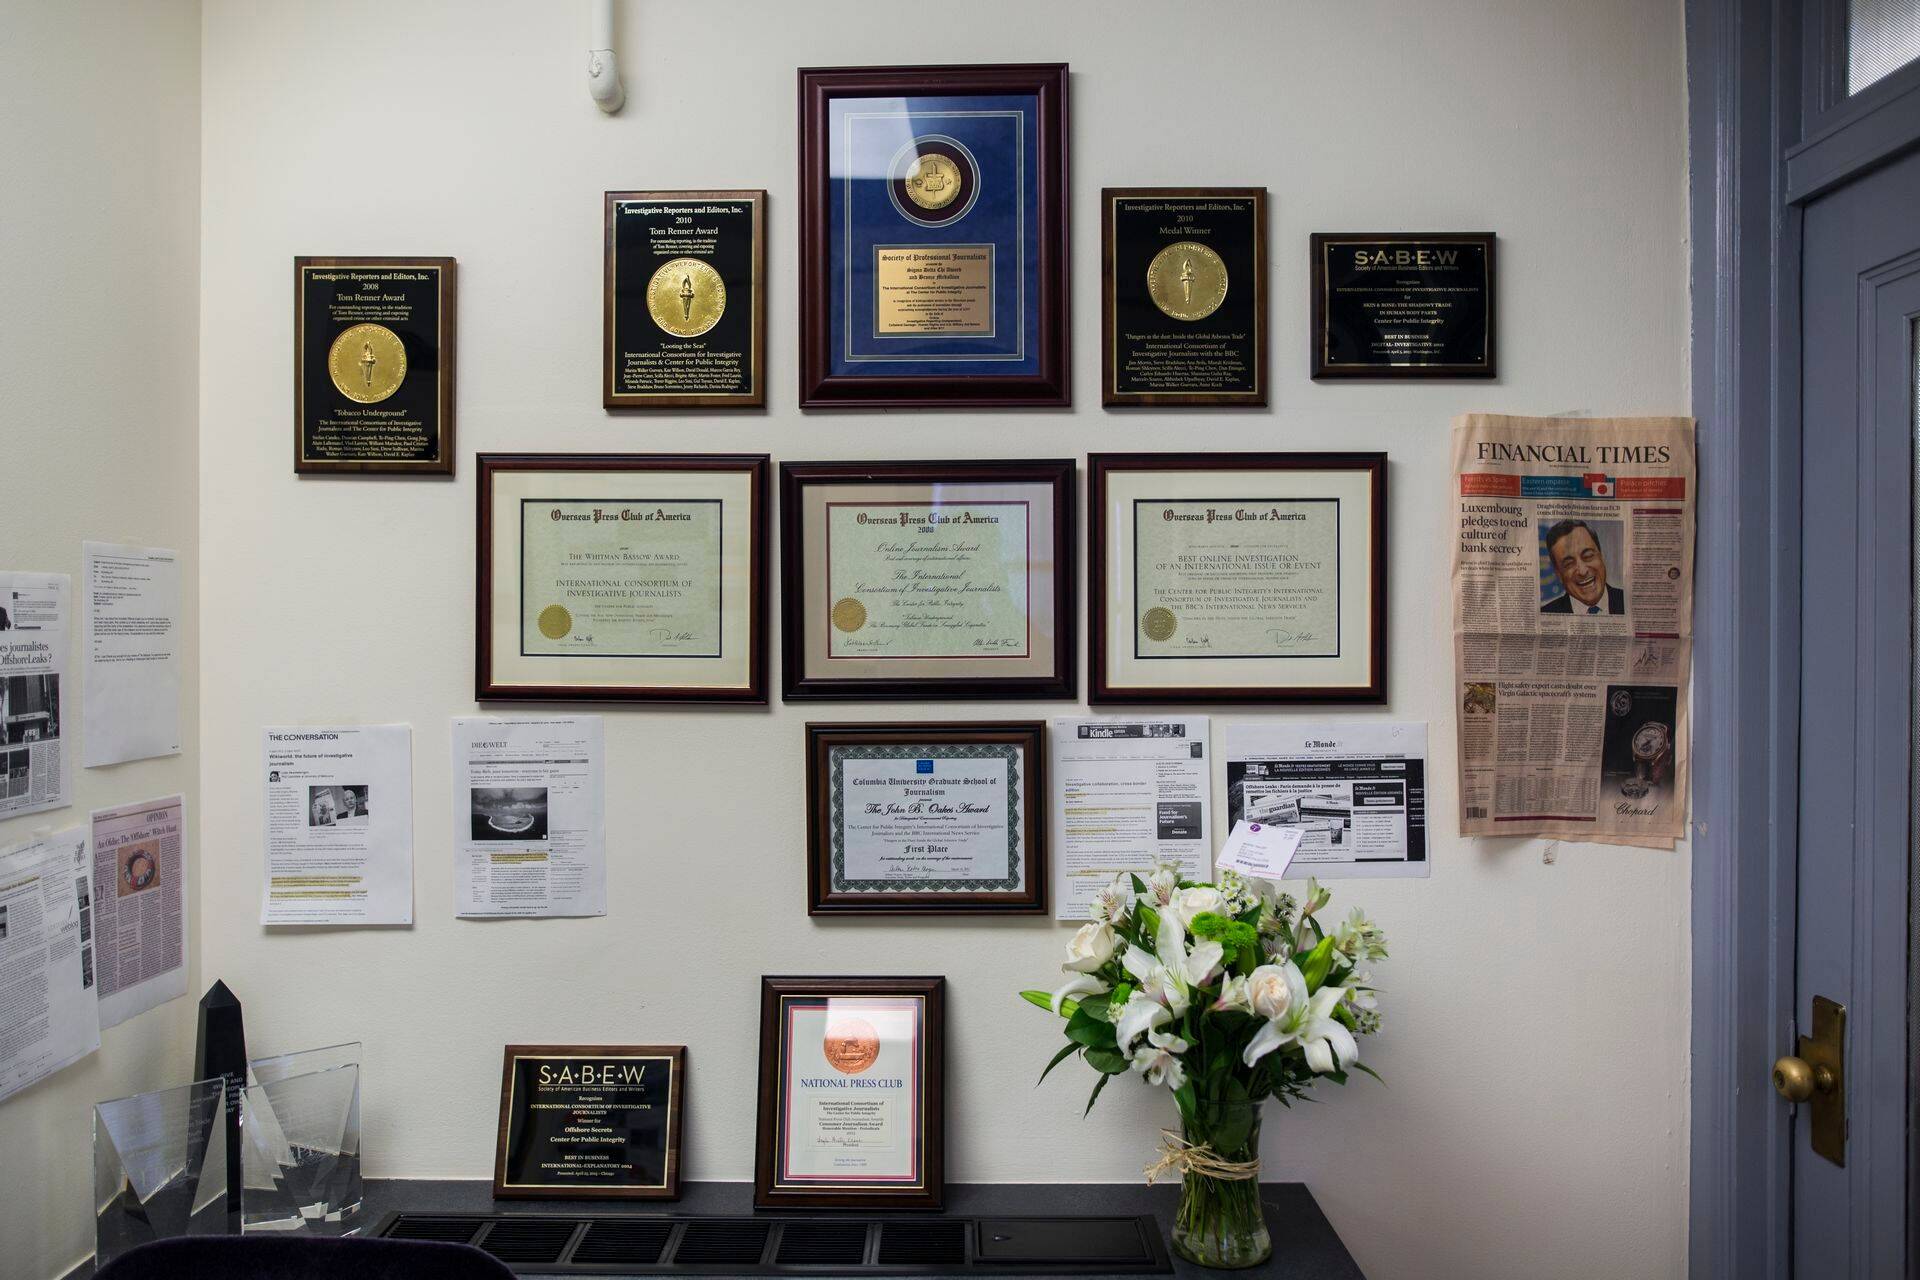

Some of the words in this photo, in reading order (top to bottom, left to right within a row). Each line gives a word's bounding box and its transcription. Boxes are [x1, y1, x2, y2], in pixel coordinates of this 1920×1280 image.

[625, 207, 662, 215] Investigative
[664, 207, 693, 215] Reporters
[707, 207, 730, 215] Editors,
[1125, 204, 1163, 212] Investigative
[1164, 204, 1194, 212] Reporters
[1208, 204, 1232, 212] Editors,
[312, 273, 349, 281] Investigative
[351, 273, 380, 281] Reporters
[394, 273, 416, 281] Editors,
[1477, 442, 1592, 463] FINANCIAL
[1597, 445, 1670, 463] TIMES
[1461, 503, 1522, 516] Luxembourg
[551, 509, 591, 521] Overseas
[593, 509, 618, 523] Press
[621, 509, 643, 521] Club
[655, 509, 691, 521] America
[856, 512, 897, 525] Overseas
[899, 512, 925, 527] Press
[927, 512, 950, 525] Club
[963, 512, 999, 525] America
[1163, 509, 1204, 522] Overseas
[1206, 509, 1233, 524] Press
[1235, 509, 1257, 522] Club
[1270, 509, 1306, 522] America
[1461, 516, 1498, 528] pledges
[1510, 518, 1528, 528] end
[1461, 530, 1497, 539] culture
[874, 542, 903, 552] Online
[904, 542, 948, 553] Journalism
[952, 541, 980, 552] Award
[1461, 542, 1486, 553] bank
[1489, 542, 1522, 556] secrecy
[1178, 555, 1198, 563] BEST
[1199, 555, 1234, 563] ONLINE
[1235, 555, 1299, 563] INVESTIGATION
[1169, 562, 1181, 570] AN
[1183, 562, 1253, 570] INTERNATIONAL
[1255, 562, 1277, 570] ISSUE
[1279, 562, 1291, 570] OR
[1293, 562, 1321, 570] EVENT
[892, 570, 908, 580] The
[910, 569, 965, 580] International
[556, 579, 622, 587] INTERNATIONAL
[624, 579, 680, 587] CONSORTIUM
[854, 582, 897, 593] Consortium
[910, 582, 958, 595] Investigative
[958, 581, 1000, 593] Journalists
[566, 590, 628, 599] INVESTIGATIVE
[630, 590, 682, 599] JOURNALISTS
[10, 640, 49, 654] journalistes
[1090, 728, 1114, 738] Kindle
[888, 778, 926, 786] University
[904, 788, 946, 797] Journalism
[864, 803, 881, 814] The
[882, 803, 906, 815] John
[908, 803, 923, 813] B.
[928, 803, 953, 813] Oakes
[956, 802, 989, 813] Award
[1614, 803, 1656, 817] Chopard
[904, 845, 924, 854] First
[926, 845, 948, 854] Place
[801, 1079, 848, 1088] NATIONAL
[850, 1079, 876, 1088] PRESS
[878, 1079, 903, 1088] CLUB
